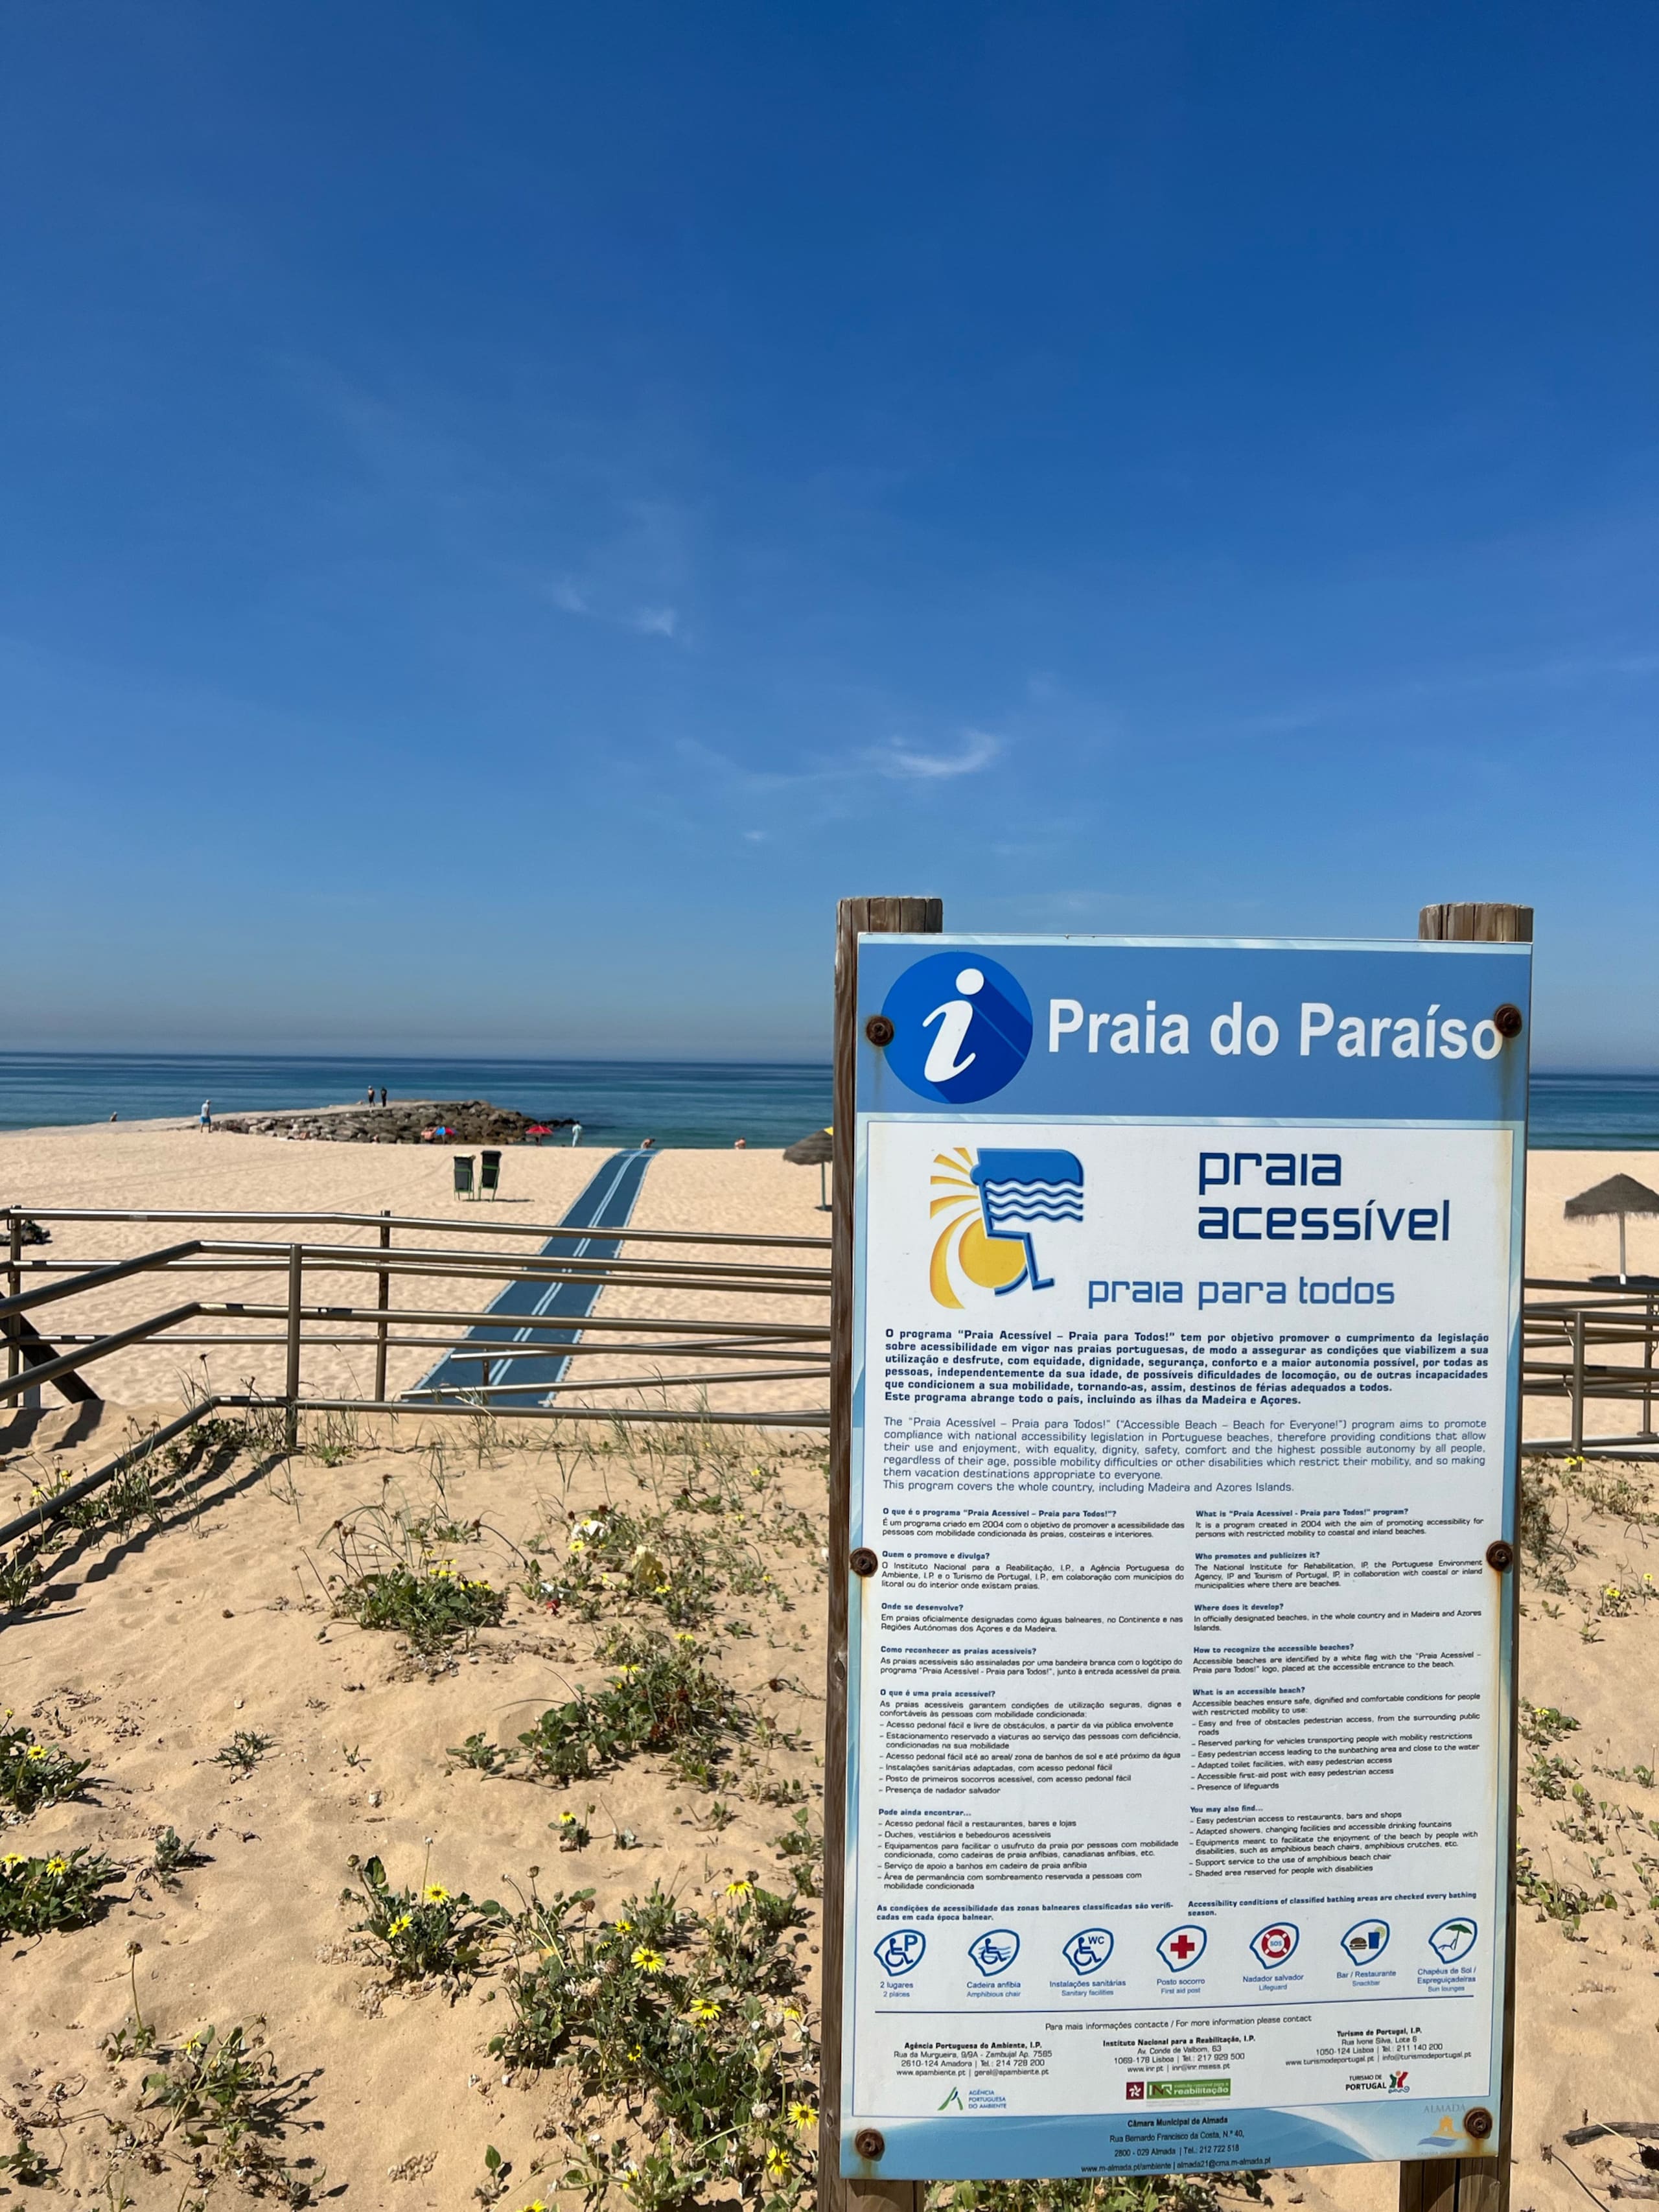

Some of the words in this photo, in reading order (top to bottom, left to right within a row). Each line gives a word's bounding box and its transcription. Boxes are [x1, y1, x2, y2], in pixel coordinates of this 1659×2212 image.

[1049, 999, 1189, 1054] Praia
[1210, 1001, 1279, 1056] do
[1301, 1003, 1503, 1060] Paraíso
[1198, 1152, 1341, 1195] praia
[1198, 1199, 1449, 1240] acessível
[1088, 1280, 1183, 1309] praia
[1198, 1281, 1286, 1310] para
[1299, 1275, 1395, 1304] todos
[885, 1329, 893, 1337] O
[899, 1331, 951, 1340] programa
[999, 1330, 1051, 1340] Acessível
[1069, 1331, 1098, 1340] Praia
[1104, 1334, 1128, 1342] para
[1180, 1333, 1201, 1342] tem
[1207, 1334, 1225, 1343] por
[1231, 1333, 1273, 1343] objetivo
[1279, 1335, 1330, 1344] promover
[1346, 1333, 1415, 1344] cumprimento
[1420, 1333, 1432, 1342] da
[1437, 1333, 1489, 1344] legislação
[885, 1392, 910, 1401] Este
[914, 1394, 966, 1403] programa
[971, 1393, 1014, 1404] abrange
[1018, 1393, 1043, 1403] todo
[1057, 1393, 1083, 1405] país,
[1087, 1394, 1135, 1404] incluindo
[1156, 1395, 1181, 1404] ilhas
[1185, 1395, 1198, 1404] da
[1201, 1395, 1246, 1404] Madeira
[1260, 1395, 1301, 1406] Açores.
[884, 1430, 942, 1441] compliance
[947, 1430, 969, 1439] with
[975, 1430, 1016, 1440] national
[1021, 1432, 1086, 1442] accessibility
[1091, 1432, 1144, 1442] legislation
[1148, 1432, 1157, 1441] in
[1161, 1432, 1222, 1443] Portuguese
[1227, 1432, 1272, 1442] beaches,
[1277, 1432, 1326, 1441] therefore
[1330, 1432, 1375, 1443] providing
[1379, 1431, 1431, 1441] conditions
[1435, 1431, 1457, 1440] that
[1461, 1431, 1486, 1440] allow
[885, 1480, 904, 1489] This
[908, 1482, 953, 1492] program
[996, 1482, 1014, 1491] the
[1017, 1482, 1048, 1491] whole
[1052, 1484, 1095, 1493] country,
[1098, 1482, 1144, 1493] including
[1148, 1482, 1190, 1492] Madeira
[1193, 1482, 1212, 1492] and
[1215, 1482, 1252, 1492] Azores
[1255, 1482, 1294, 1491] Islands.
[957, 1552, 990, 1561] divulga?
[1270, 1552, 1306, 1560] publicizes
[1251, 1603, 1284, 1611] develop?
[964, 1647, 988, 1656] praias
[1223, 1646, 1260, 1654] recognize
[1087, 1936, 1104, 1944] WC
[1417, 1968, 1448, 1977] Chapéus
[1450, 1967, 1459, 1977] de
[1049, 1980, 1090, 1988] Instalações
[1417, 1975, 1476, 1985] Espreguiçadeiras
[887, 1981, 913, 1990] lugares
[1259, 1983, 1287, 1992] Lifeguard
[904, 2042, 933, 2050] Agência
[935, 2042, 977, 2051] Portuguesa
[1345, 2082, 1386, 2091] PORTUGAL
[1155, 2117, 1190, 2127] Municipal
[1201, 2115, 1227, 2125] Almada
[1109, 2134, 1123, 2143] Rua
[1124, 2133, 1155, 2142] Bernardo
[1157, 2132, 1189, 2141] Francisco
[1190, 2131, 1198, 2139] da
[1200, 2130, 1221, 2139] Costa,
[1234, 2129, 1244, 2138] 40,
